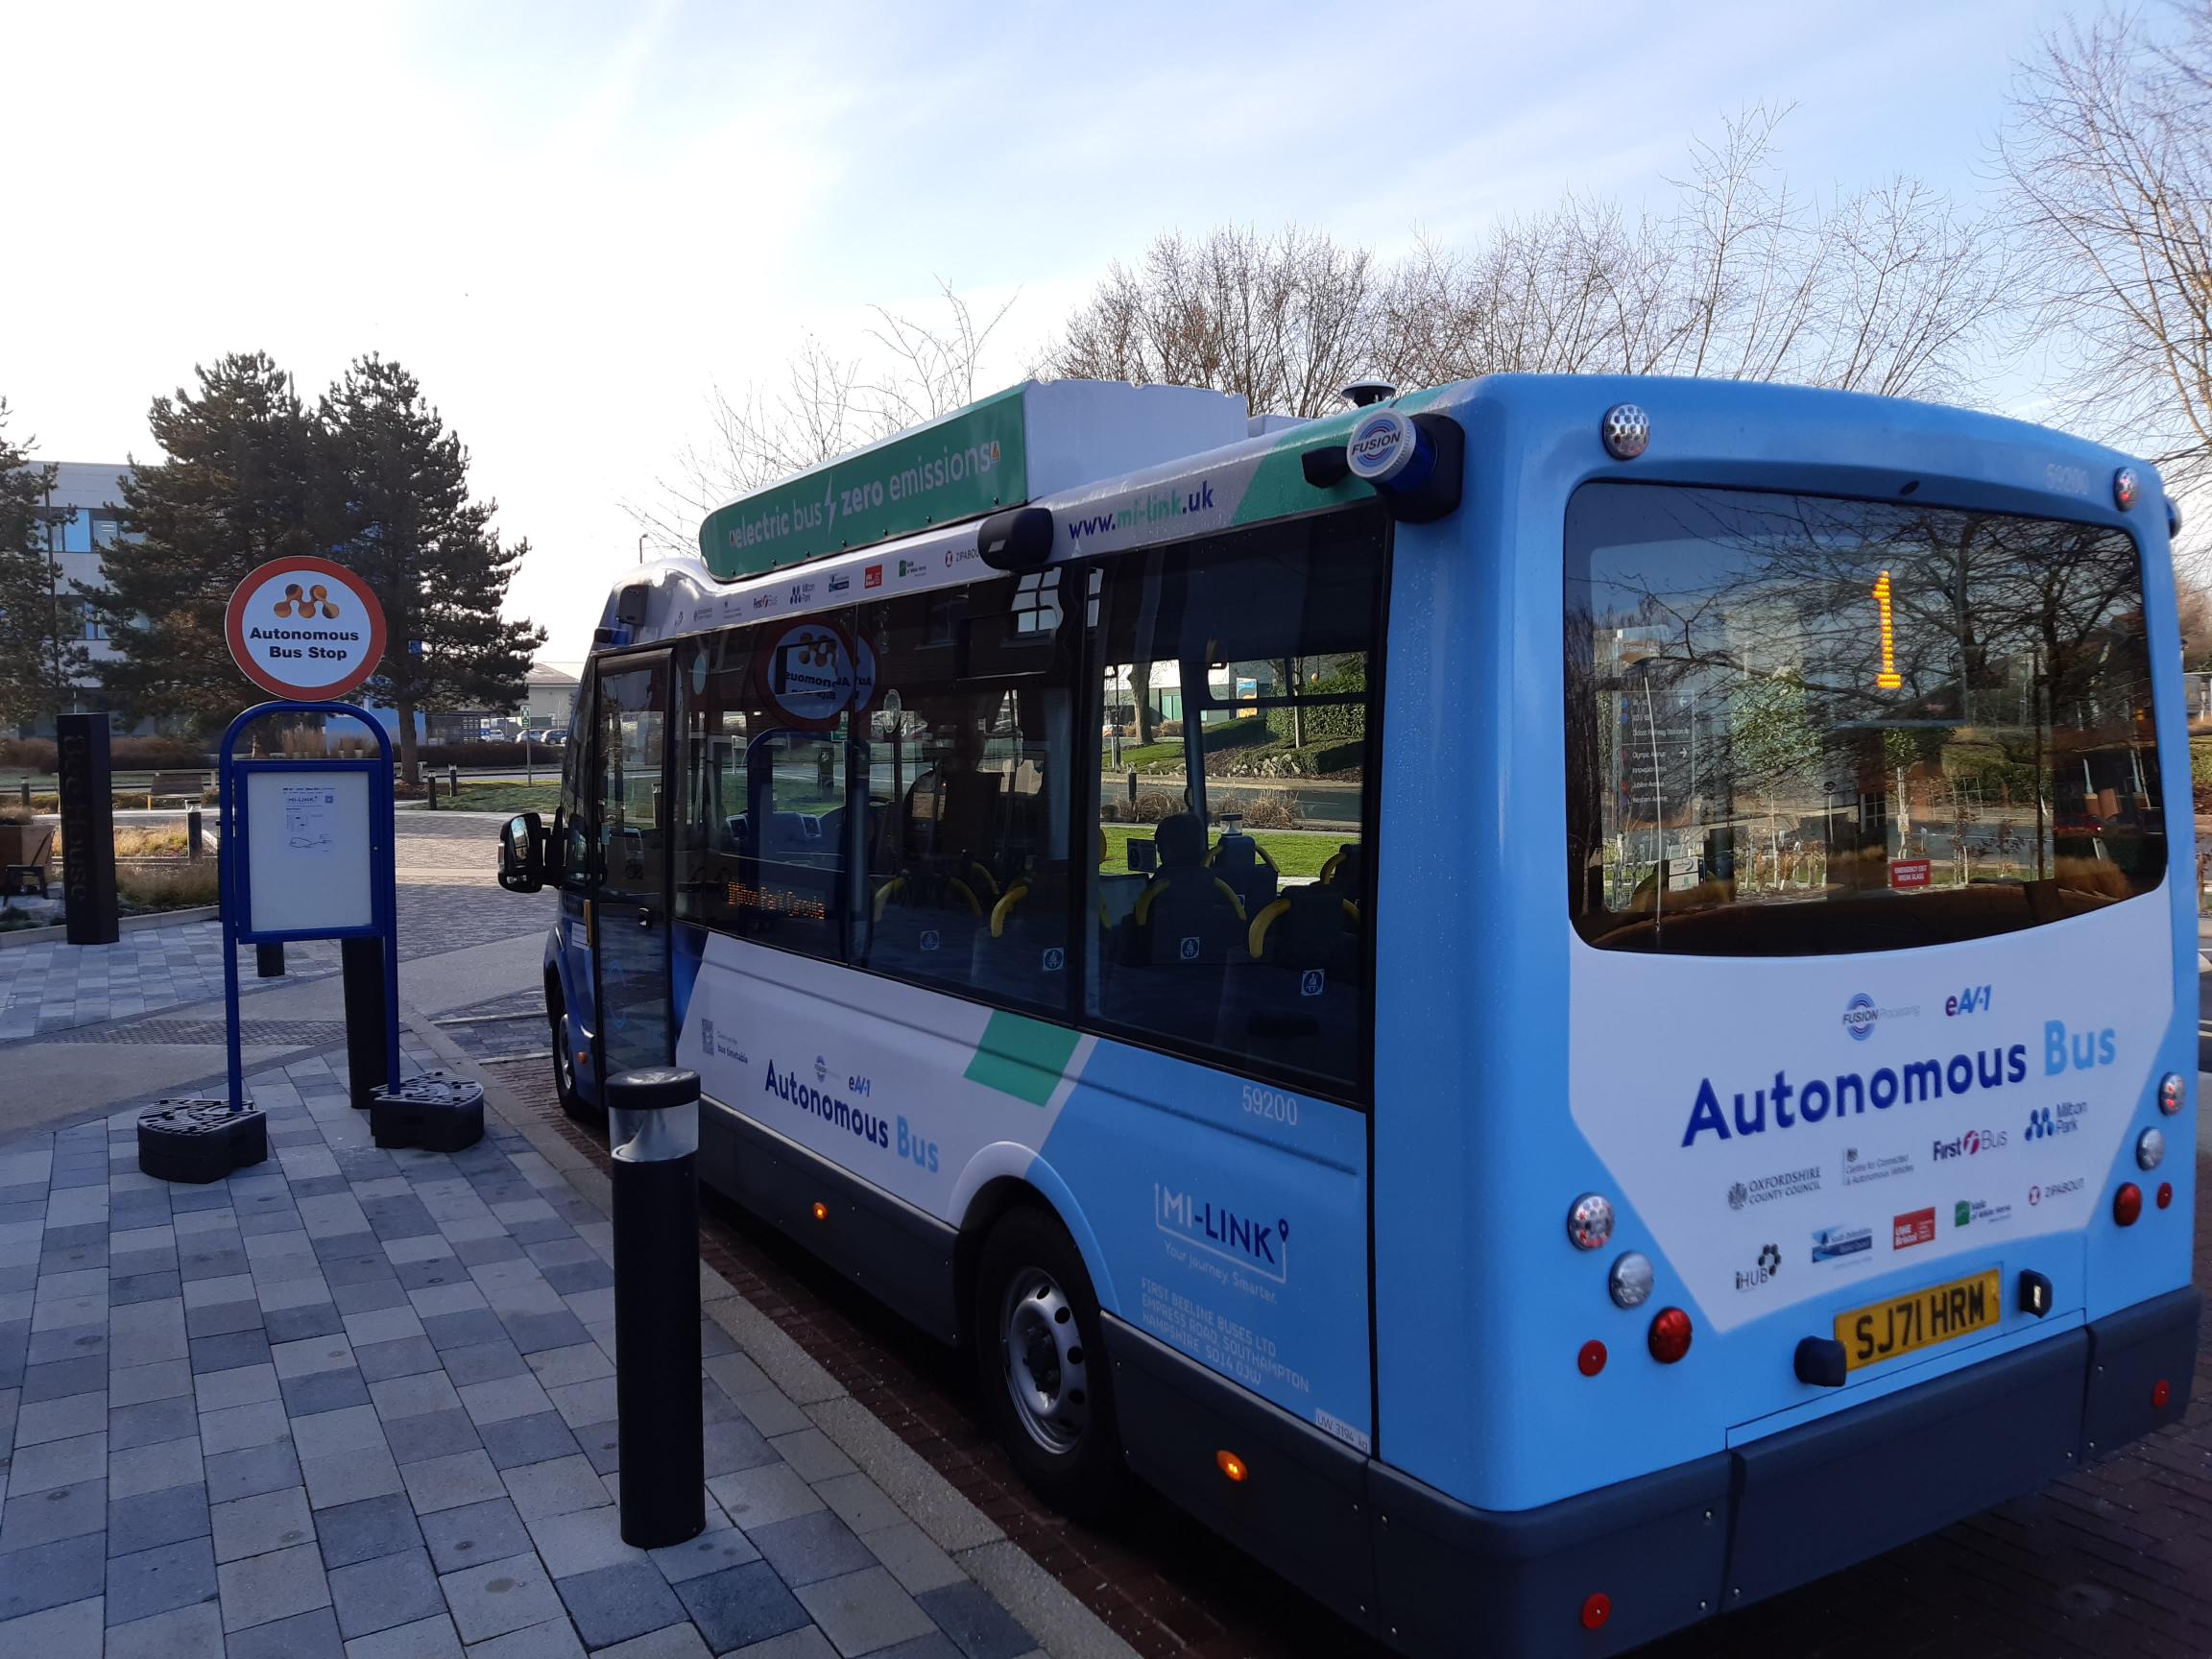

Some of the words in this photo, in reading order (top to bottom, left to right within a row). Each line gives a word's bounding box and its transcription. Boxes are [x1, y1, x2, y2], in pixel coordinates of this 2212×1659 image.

[1352, 431, 1402, 456] FUSION
[735, 511, 789, 548] electric
[793, 499, 822, 529] bus
[841, 481, 883, 517] zero
[890, 441, 992, 497] emissions
[1069, 480, 1214, 540] www.mi-link.uk
[956, 547, 979, 563] ZIPABOU
[250, 627, 359, 641] Autonomous
[1869, 569, 1902, 690] 1
[270, 645, 302, 659] Bus
[308, 646, 348, 661] Stop
[1842, 1009, 1879, 1025] FUSION
[1681, 1044, 2027, 1148] Autonomous
[2044, 1020, 2118, 1077] Bus
[764, 1059, 889, 1149] Autonomous
[897, 1114, 939, 1173] Bus
[1242, 1084, 1297, 1126] 59200
[2056, 1101, 2087, 1118] Milton
[2056, 1117, 2080, 1135] Park
[1933, 1137, 1962, 1162] First
[1982, 1129, 2008, 1151] Bus
[1748, 1166, 1821, 1192] OXFORDSHIRE
[1748, 1189, 1783, 1205] COUNTY
[1785, 1180, 1821, 1197] COUNCIL
[1164, 1185, 1275, 1264] MI-LINK
[1164, 1238, 1187, 1262] Your
[1736, 1268, 1768, 1290] iHUB
[1142, 1277, 1168, 1301] FIRST
[1171, 1292, 1214, 1326] BEELINE
[1217, 1316, 1253, 1344] BUSES
[1256, 1335, 1276, 1358] LTD
[1856, 1301, 1922, 1361] SJ71
[1931, 1279, 1985, 1337] HRM
[1142, 1293, 1187, 1327] EMPRESS
[1223, 1336, 1310, 1393] SOUTHAMPTON
[1317, 1413, 1334, 1431] UW
[1335, 1423, 1355, 1441] 3194
